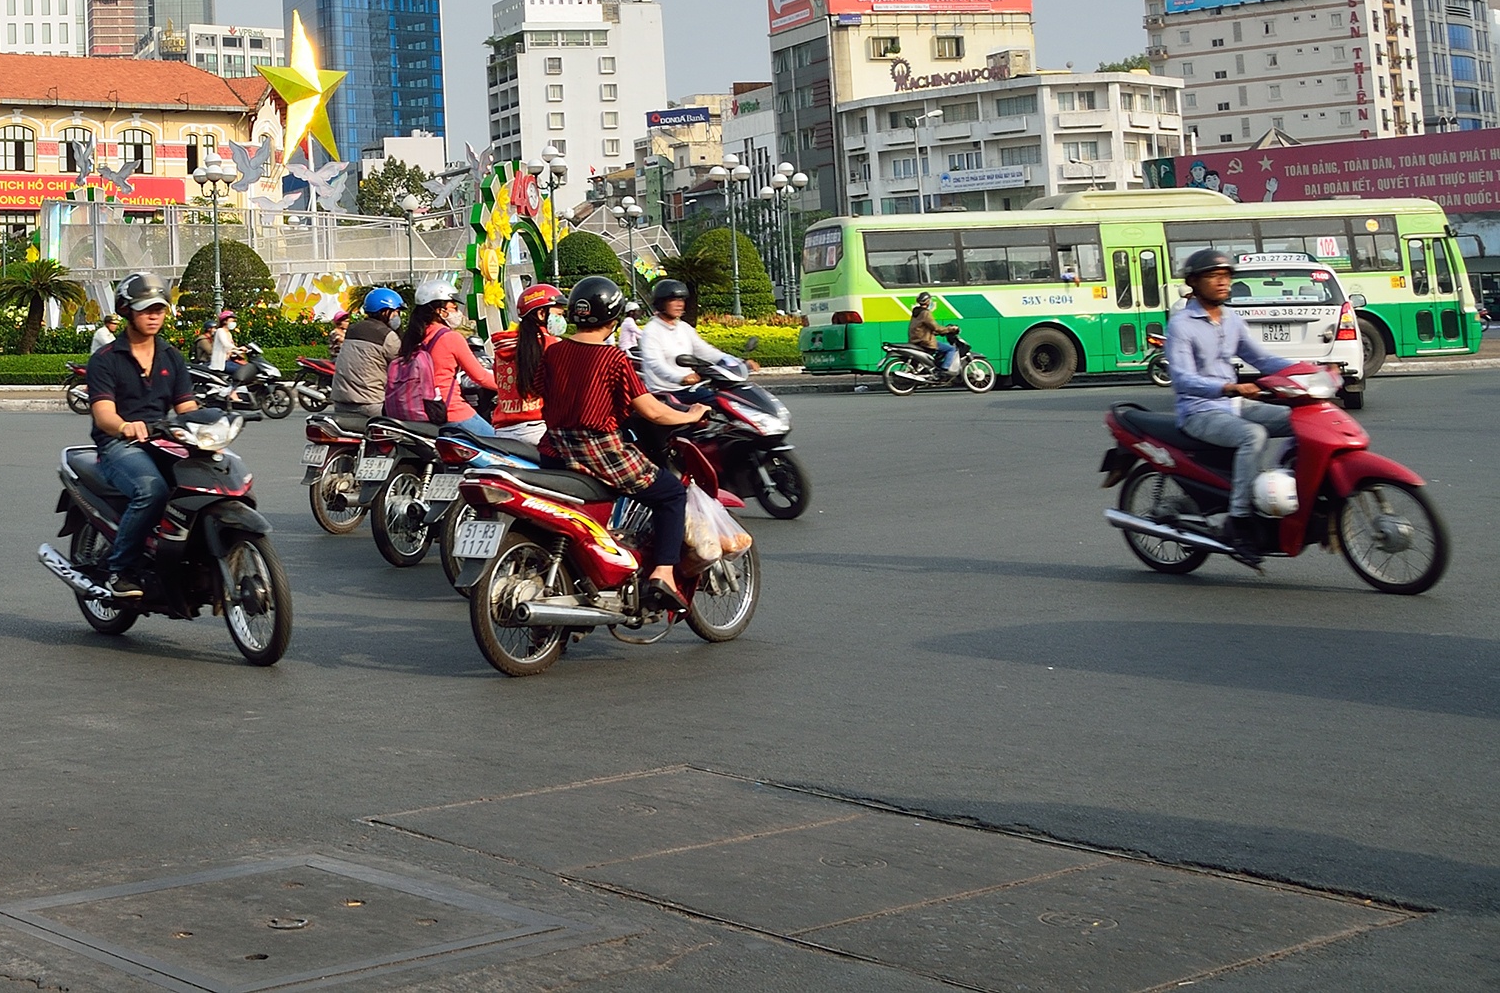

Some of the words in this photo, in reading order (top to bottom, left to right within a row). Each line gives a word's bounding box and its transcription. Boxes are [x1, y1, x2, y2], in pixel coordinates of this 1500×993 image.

[1352, 47, 1368, 121] THIÊN
[686, 114, 706, 122] Bank
[1284, 163, 1309, 177] TOÀN
[1312, 159, 1340, 175] ĐẢNG,
[1343, 159, 1370, 172] TOÀN
[1372, 156, 1396, 171] DÂN,
[1398, 153, 1426, 168] TOÀN
[1428, 151, 1456, 166] QUÂN
[1459, 147, 1486, 163] PHÁT
[0, 180, 25, 193] TỊCH
[28, 178, 44, 190] HỒ
[47, 179, 68, 191] CHÍ
[1304, 183, 1321, 198] ĐẠI
[1323, 180, 1350, 195] ĐOÀN
[1352, 177, 1375, 192] KẾT,
[1377, 174, 1410, 190] QUYẾT
[1413, 172, 1436, 188] TÂM
[1438, 171, 1466, 188] THỰC
[1468, 169, 1494, 188] HIỆN
[29, 194, 44, 206] SỰ
[122, 195, 163, 206] CHÚNG
[1433, 192, 1461, 207] TOÀN
[1464, 188, 1492, 205] QUỐC
[1319, 237, 1335, 256] 102
[1255, 254, 1280, 262] 38.27
[1283, 254, 1293, 262] 27
[1296, 254, 1306, 262] 27
[1281, 308, 1307, 316] 38.27
[1311, 308, 1322, 316] 27
[1268, 325, 1284, 333] 51A
[465, 522, 497, 539] 51-R3
[460, 539, 492, 555] 1174
